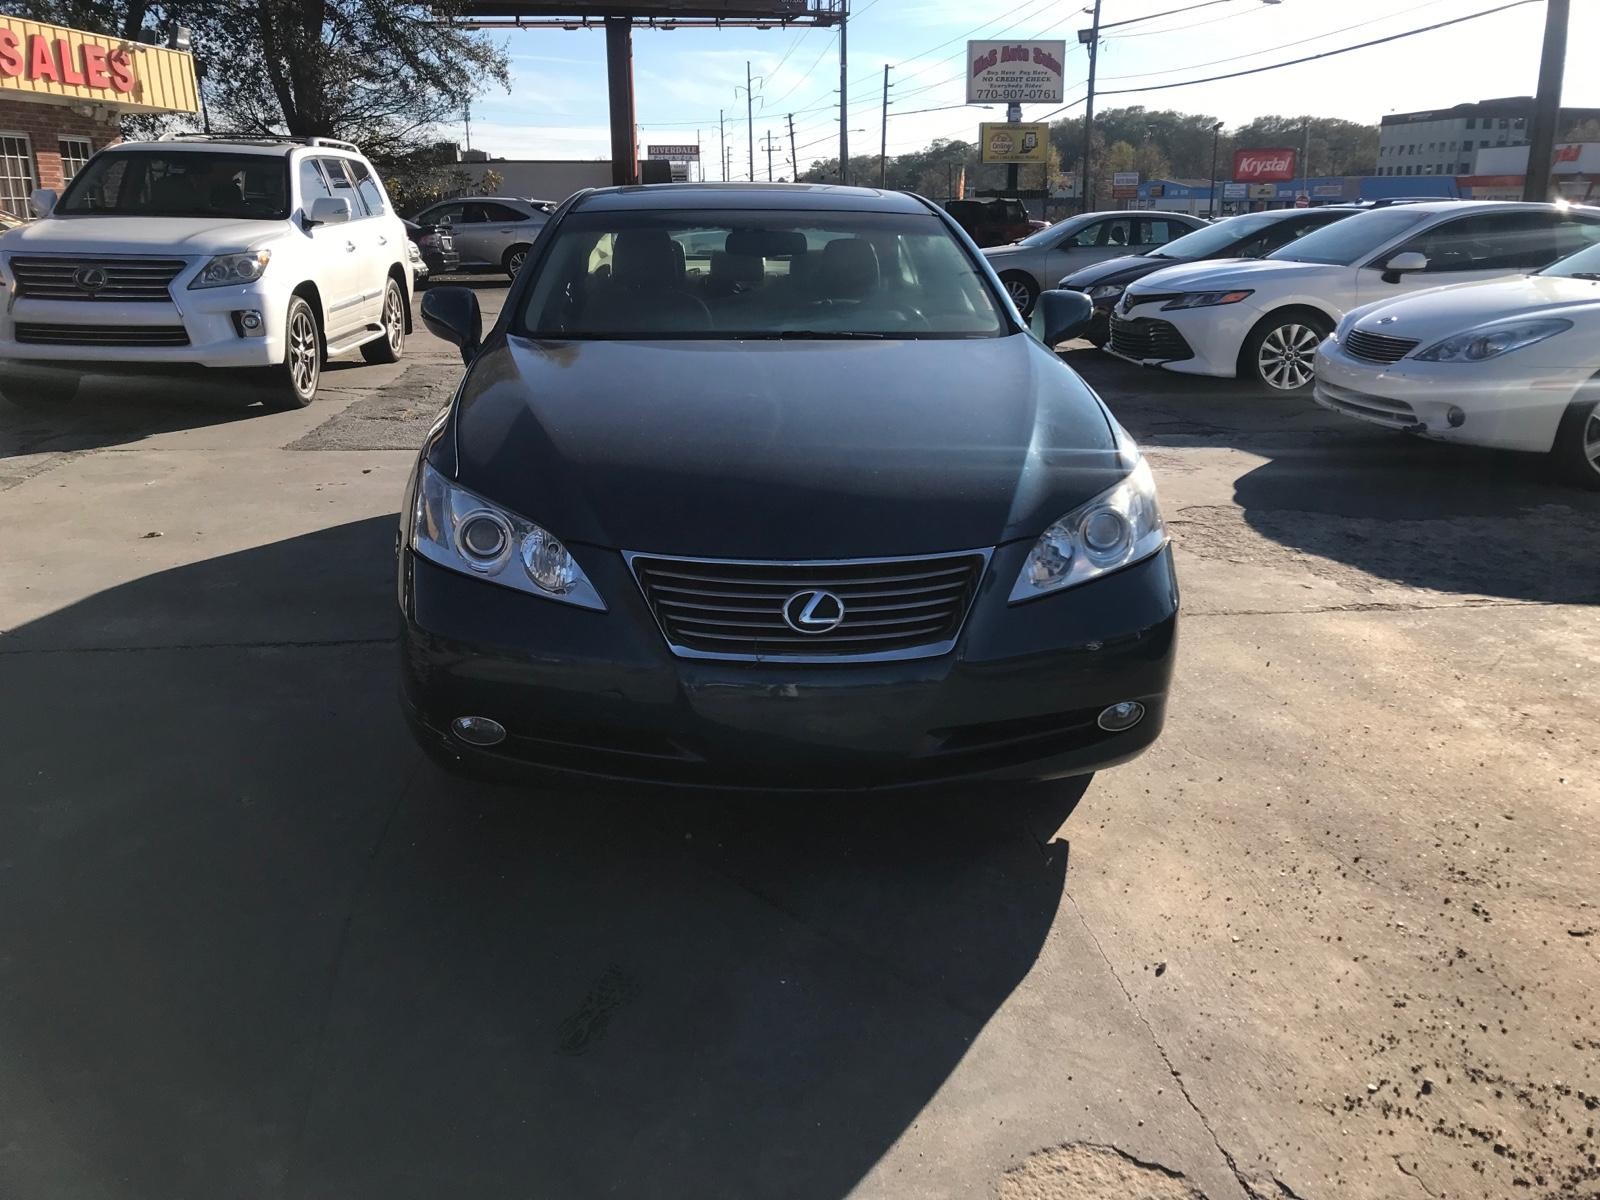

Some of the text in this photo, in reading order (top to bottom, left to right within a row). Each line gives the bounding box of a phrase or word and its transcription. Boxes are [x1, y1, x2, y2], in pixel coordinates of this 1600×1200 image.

[0, 28, 135, 93] SALES
[1001, 45, 1029, 63] Auto
[1033, 47, 1062, 77] Sales
[976, 89, 1057, 99] 770-907-0761
[650, 146, 697, 154] RIVERDALE
[1239, 157, 1291, 176] Krystal
